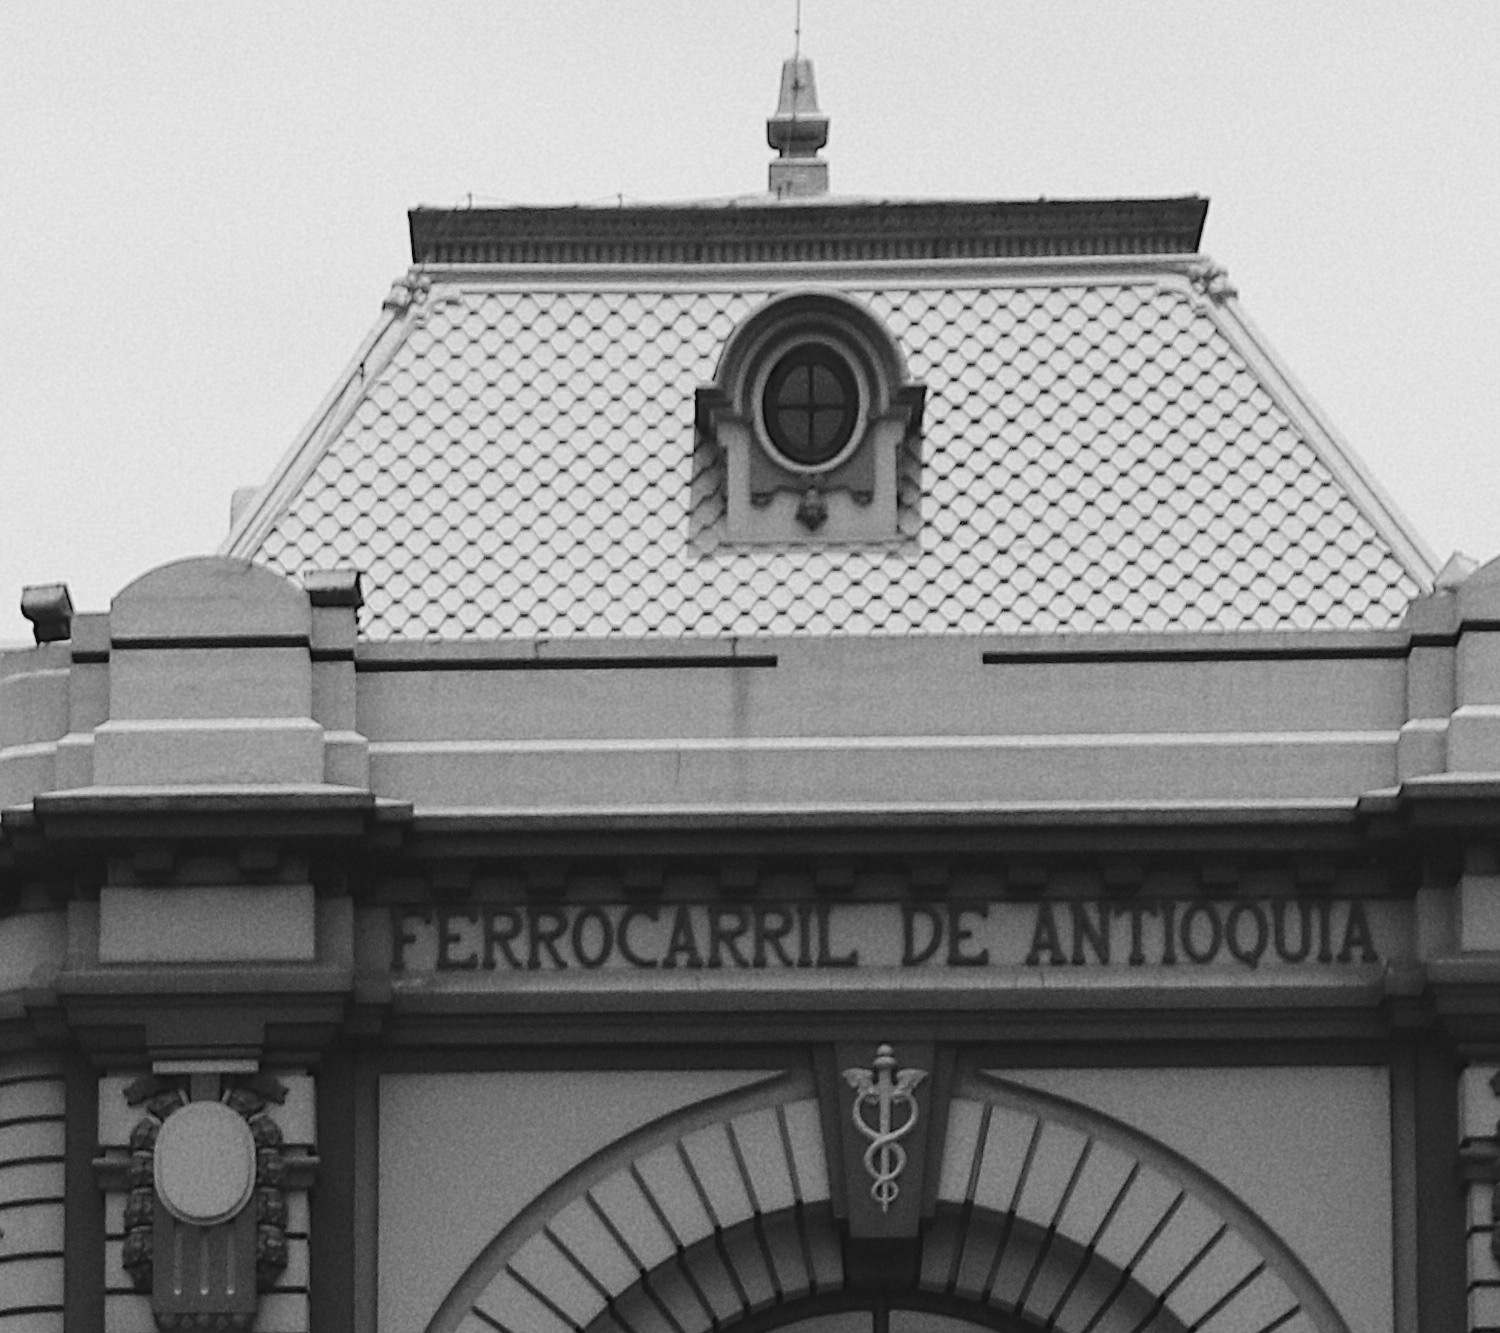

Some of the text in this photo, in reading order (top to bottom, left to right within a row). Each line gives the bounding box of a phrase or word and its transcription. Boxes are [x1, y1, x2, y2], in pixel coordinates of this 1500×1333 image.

[390, 903, 1379, 971] FERROCARRIL DE ANTIOQUIA
